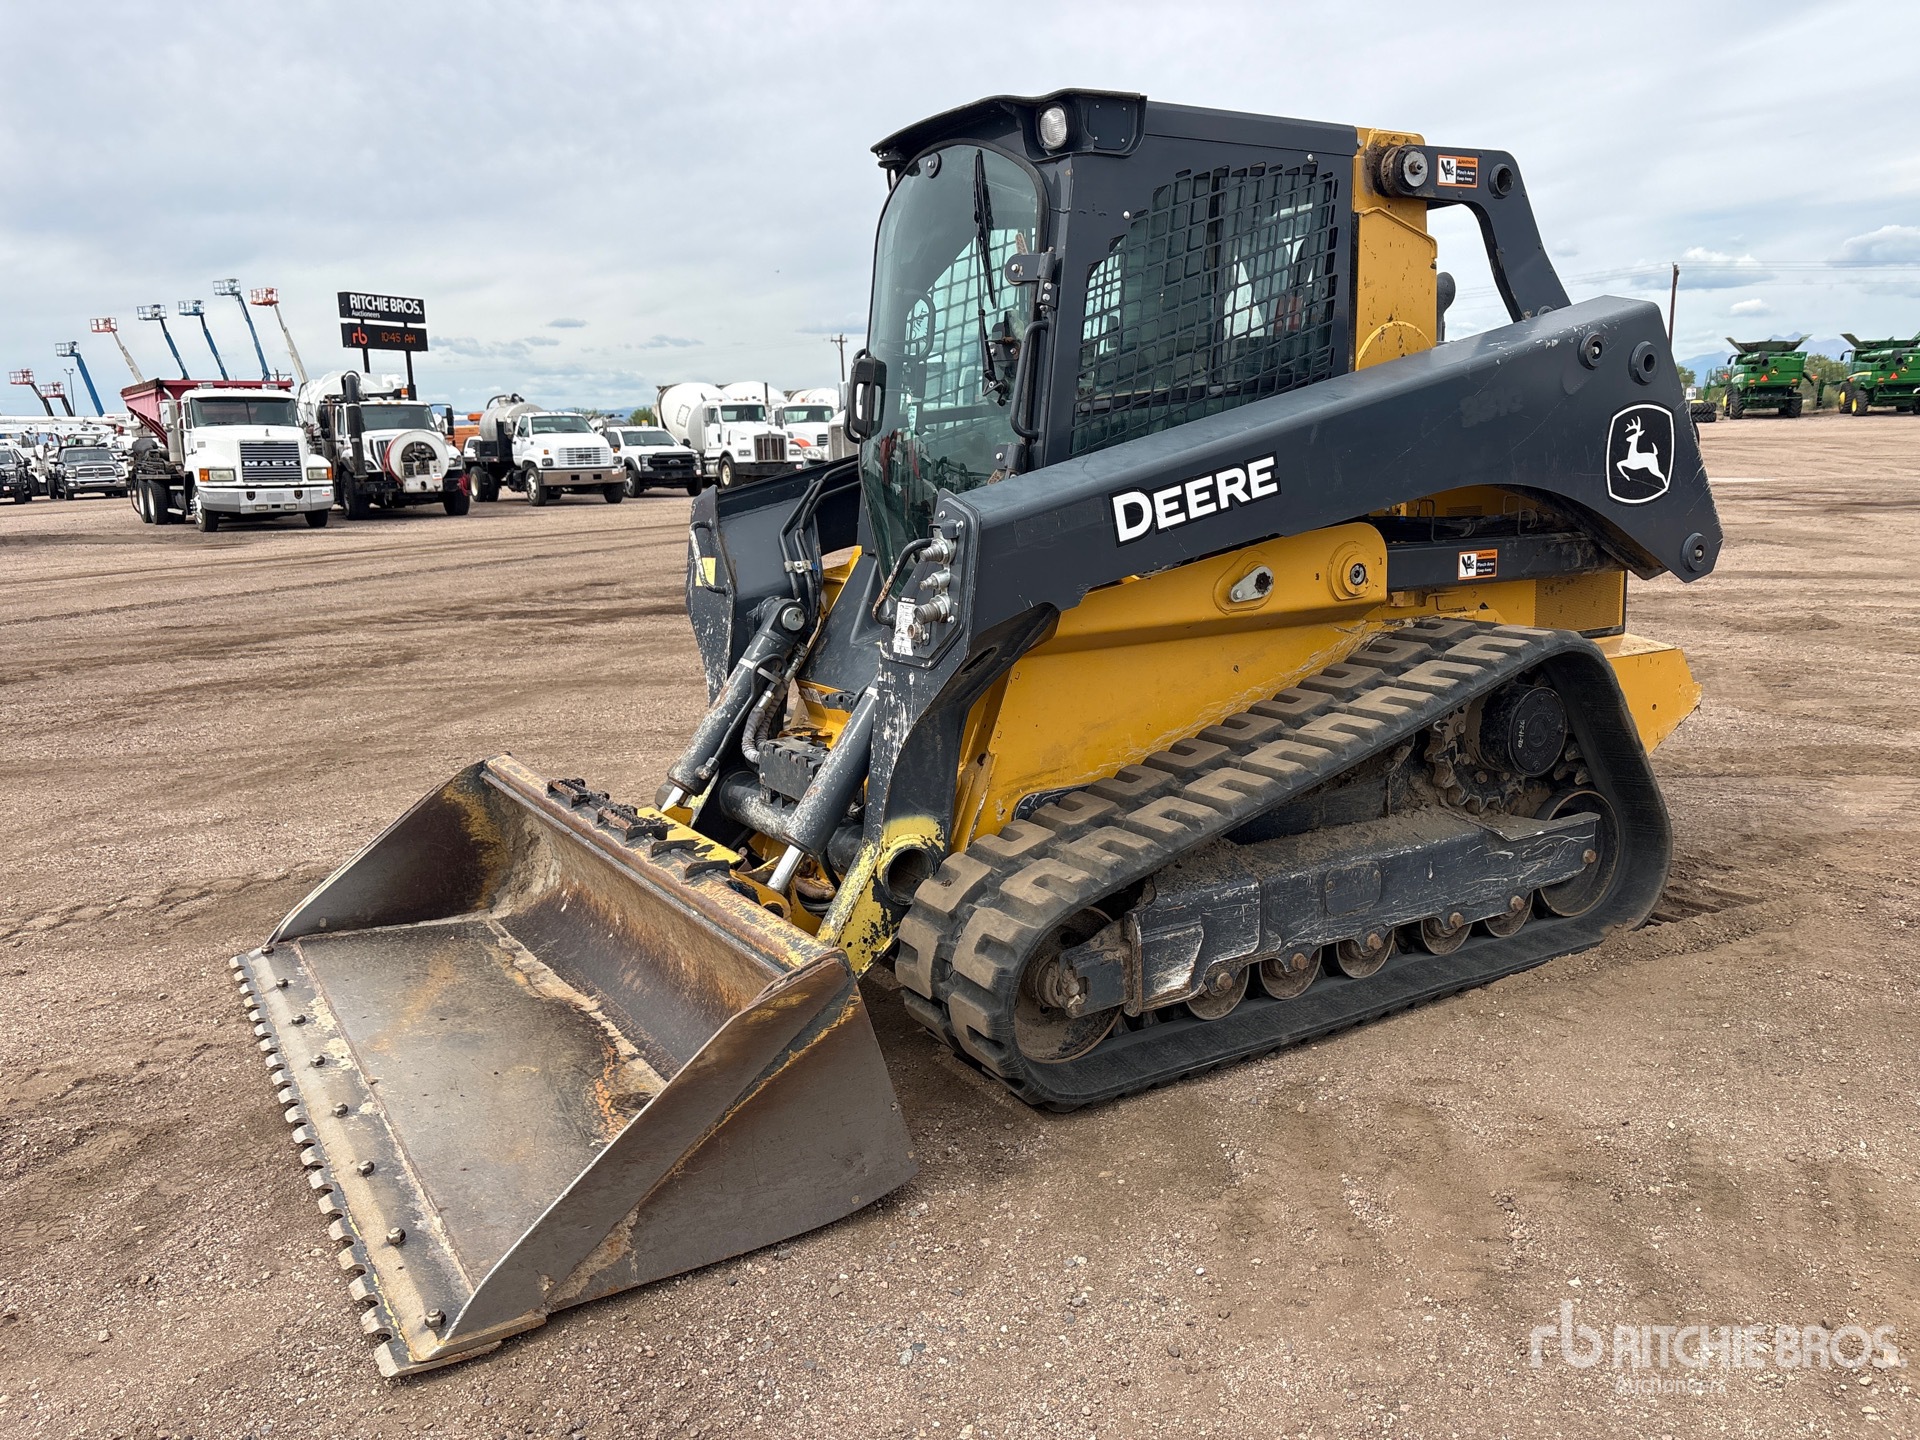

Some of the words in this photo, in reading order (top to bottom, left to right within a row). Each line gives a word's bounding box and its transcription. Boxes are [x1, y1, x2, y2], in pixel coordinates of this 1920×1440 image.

[349, 294, 390, 312] RITCHIE
[390, 298, 423, 315] BROS.
[351, 309, 381, 319] Auctioneers
[352, 326, 368, 345] rb
[381, 332, 401, 343] 10:45
[404, 334, 416, 344] AM
[1112, 455, 1279, 543] DEERE
